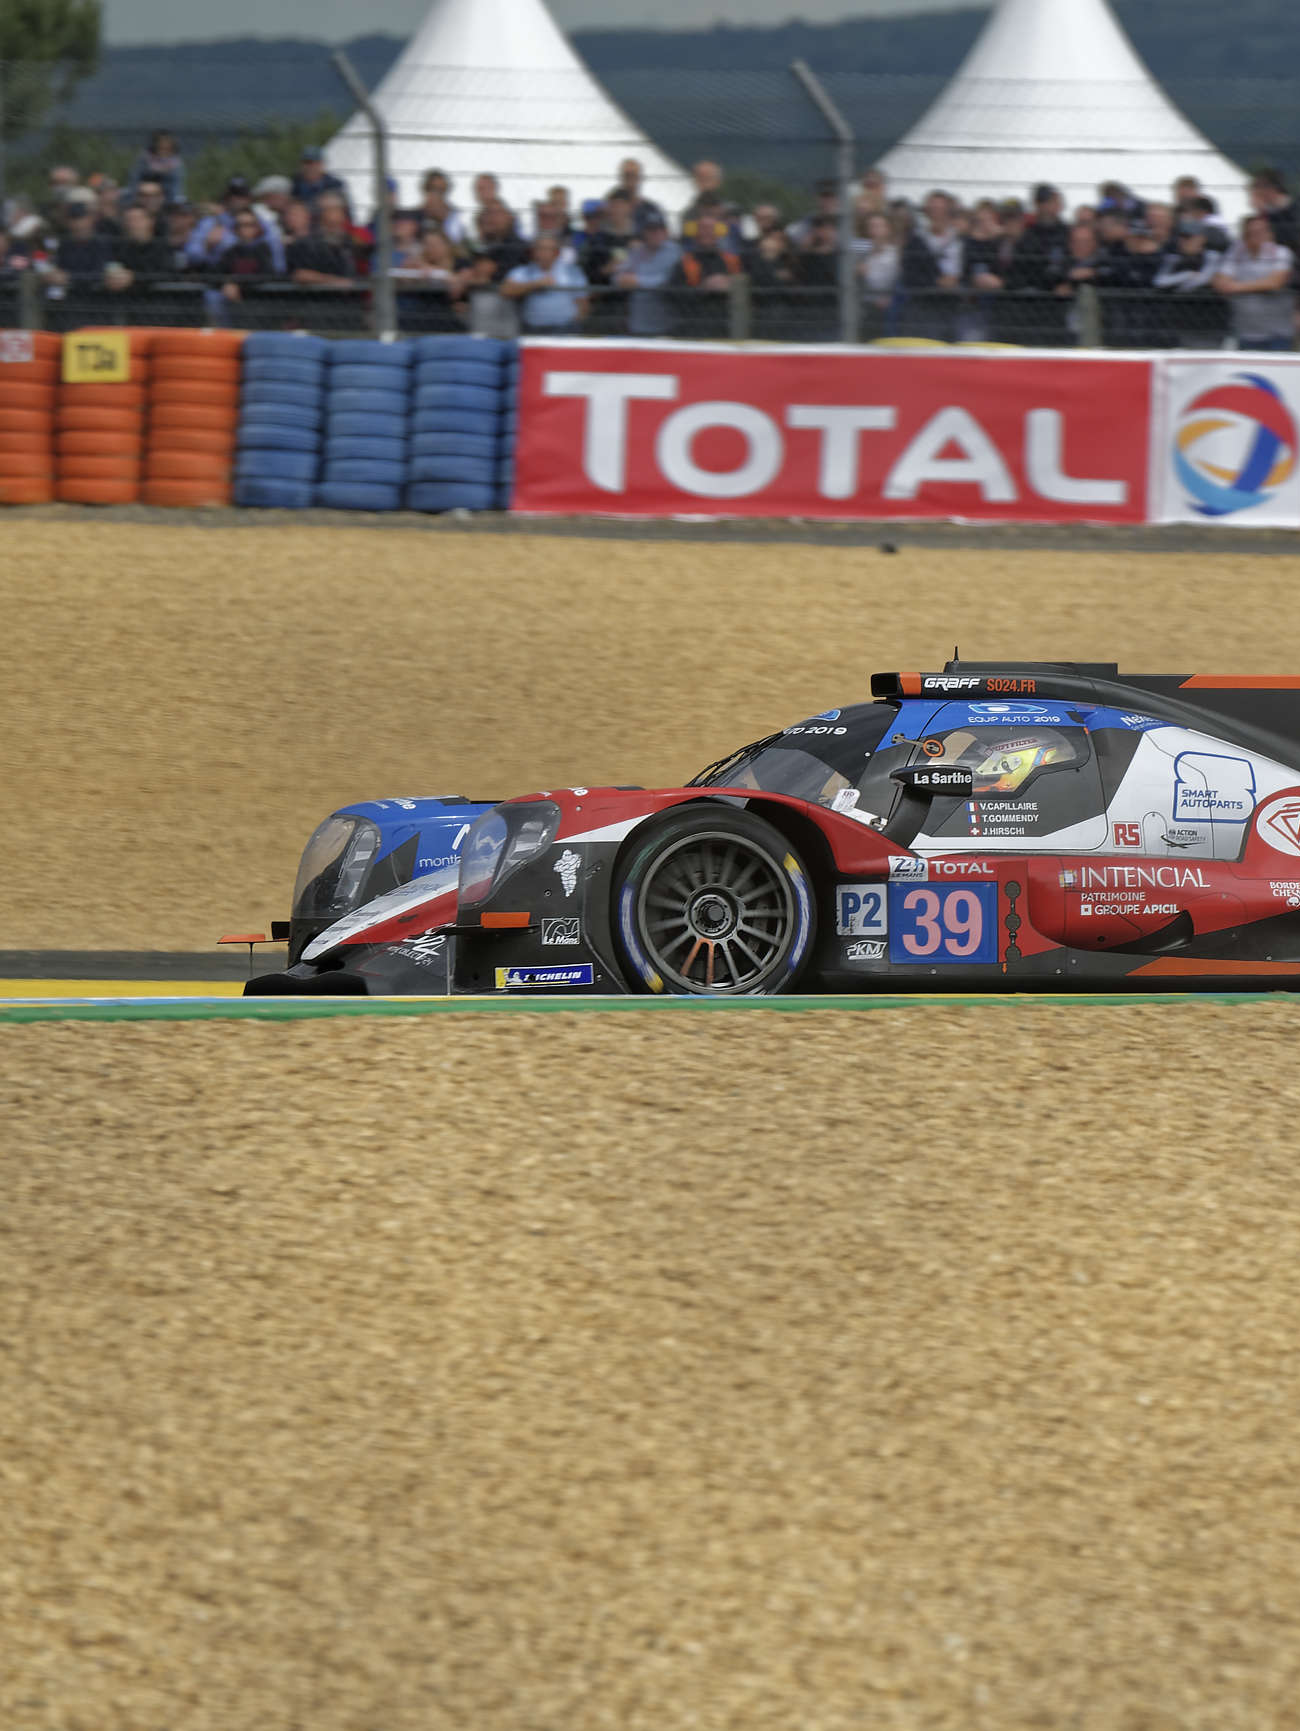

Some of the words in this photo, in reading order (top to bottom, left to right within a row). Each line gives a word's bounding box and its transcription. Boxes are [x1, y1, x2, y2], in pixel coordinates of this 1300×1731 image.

[924, 677, 980, 691] GRAFF
[805, 726, 847, 735] 2019
[914, 772, 929, 785] La
[932, 772, 972, 784] Sarthe
[1181, 789, 1219, 798] SMART
[979, 803, 1038, 811] V.CAPILLAIRE
[1180, 800, 1243, 810] AUTOPARTS
[982, 815, 1039, 823] T.GOMMENDY
[982, 827, 1025, 836] J.HIRSCHI
[930, 860, 994, 874] TOTAL
[1081, 866, 1211, 888] INTENCIAL
[1081, 892, 1146, 902] PATRIMOINE
[841, 892, 882, 928] P2
[1095, 905, 1140, 914] GROUPE
[1143, 904, 1181, 914] APICIL
[902, 889, 983, 956] 39
